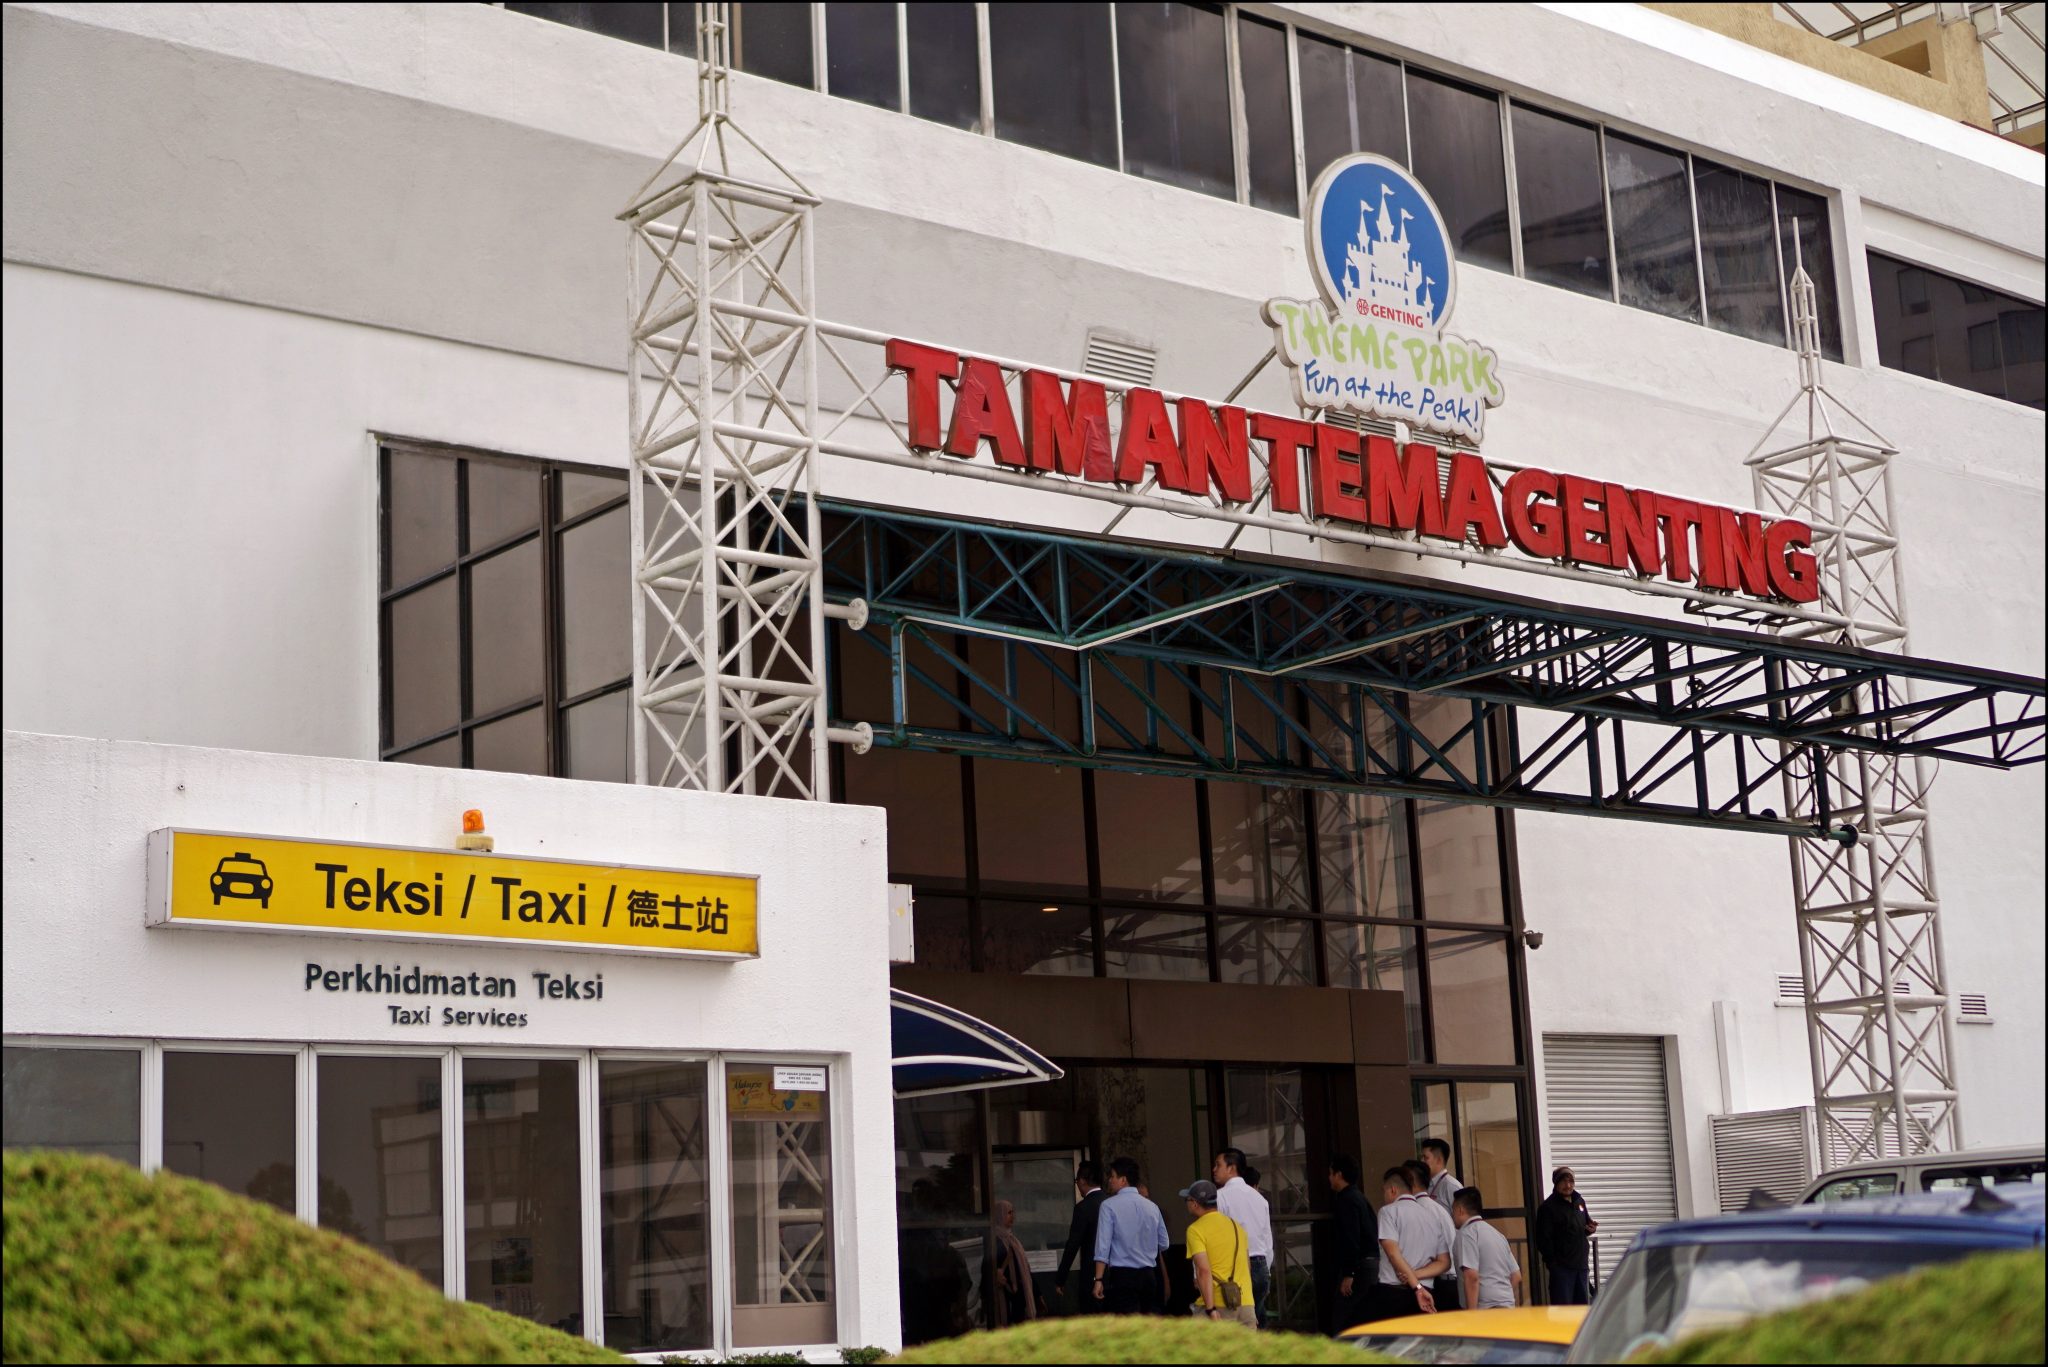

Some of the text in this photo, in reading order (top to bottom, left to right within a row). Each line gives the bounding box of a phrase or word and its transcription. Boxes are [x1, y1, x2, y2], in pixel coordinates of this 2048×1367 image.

[1371, 304, 1424, 329] GENTING
[1276, 304, 1498, 396] THEME PARK
[1304, 359, 1481, 433] Fun at the Peak!
[315, 862, 443, 917] Teksi
[491, 876, 587, 926] Taxi
[626, 888, 729, 935] 德士站
[305, 963, 604, 1001] Perkhidmatan Teksi
[388, 1005, 528, 1028] Taxi Services
